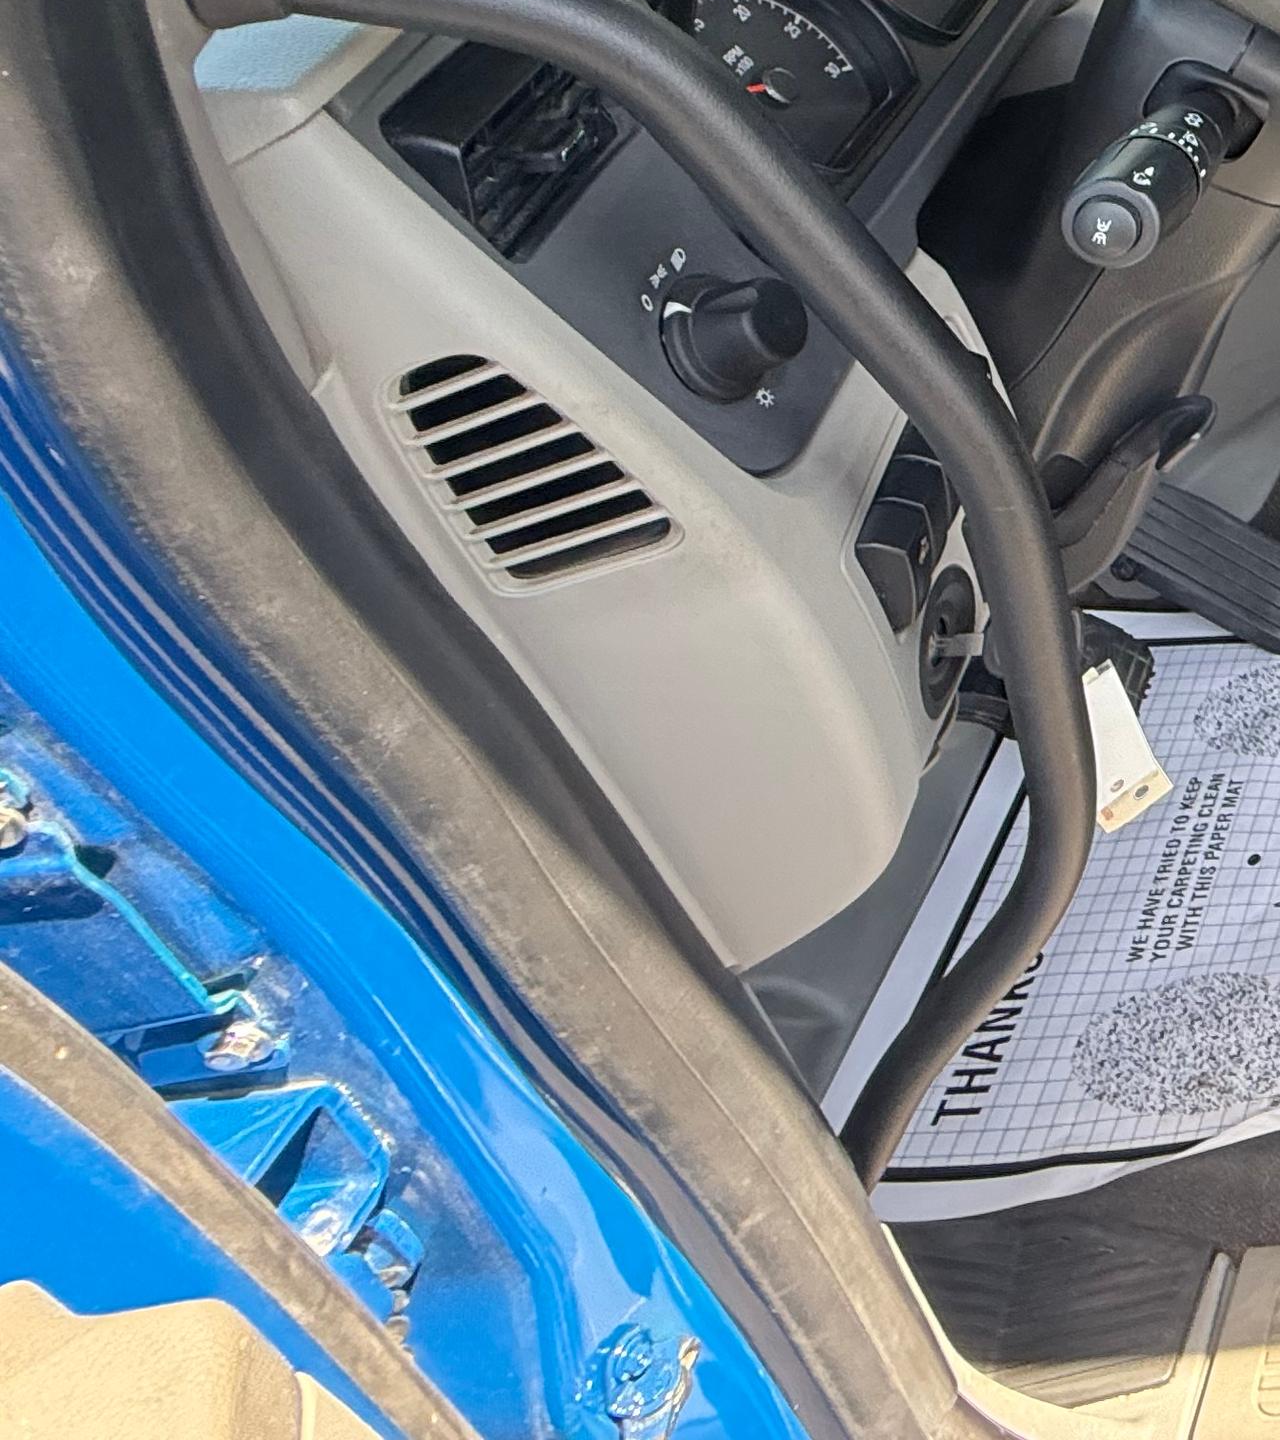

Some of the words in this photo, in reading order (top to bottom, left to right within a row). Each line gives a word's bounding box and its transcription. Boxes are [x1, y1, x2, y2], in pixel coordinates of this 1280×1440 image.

[731, 3, 751, 22] 20
[1178, 776, 1202, 810] KEEP
[1220, 778, 1243, 808] MAT
[1169, 814, 1189, 832] TO
[1203, 812, 1233, 860] PAPER
[1148, 913, 1179, 962] YOUR
[1165, 822, 1209, 909] CARPETING
[1197, 772, 1225, 818] CLEAN
[1151, 838, 1181, 882] TRIED
[1190, 865, 1217, 901] THIS
[1136, 888, 1165, 929] HAVE
[1174, 906, 1204, 951] WITH
[1125, 934, 1149, 962] WE
